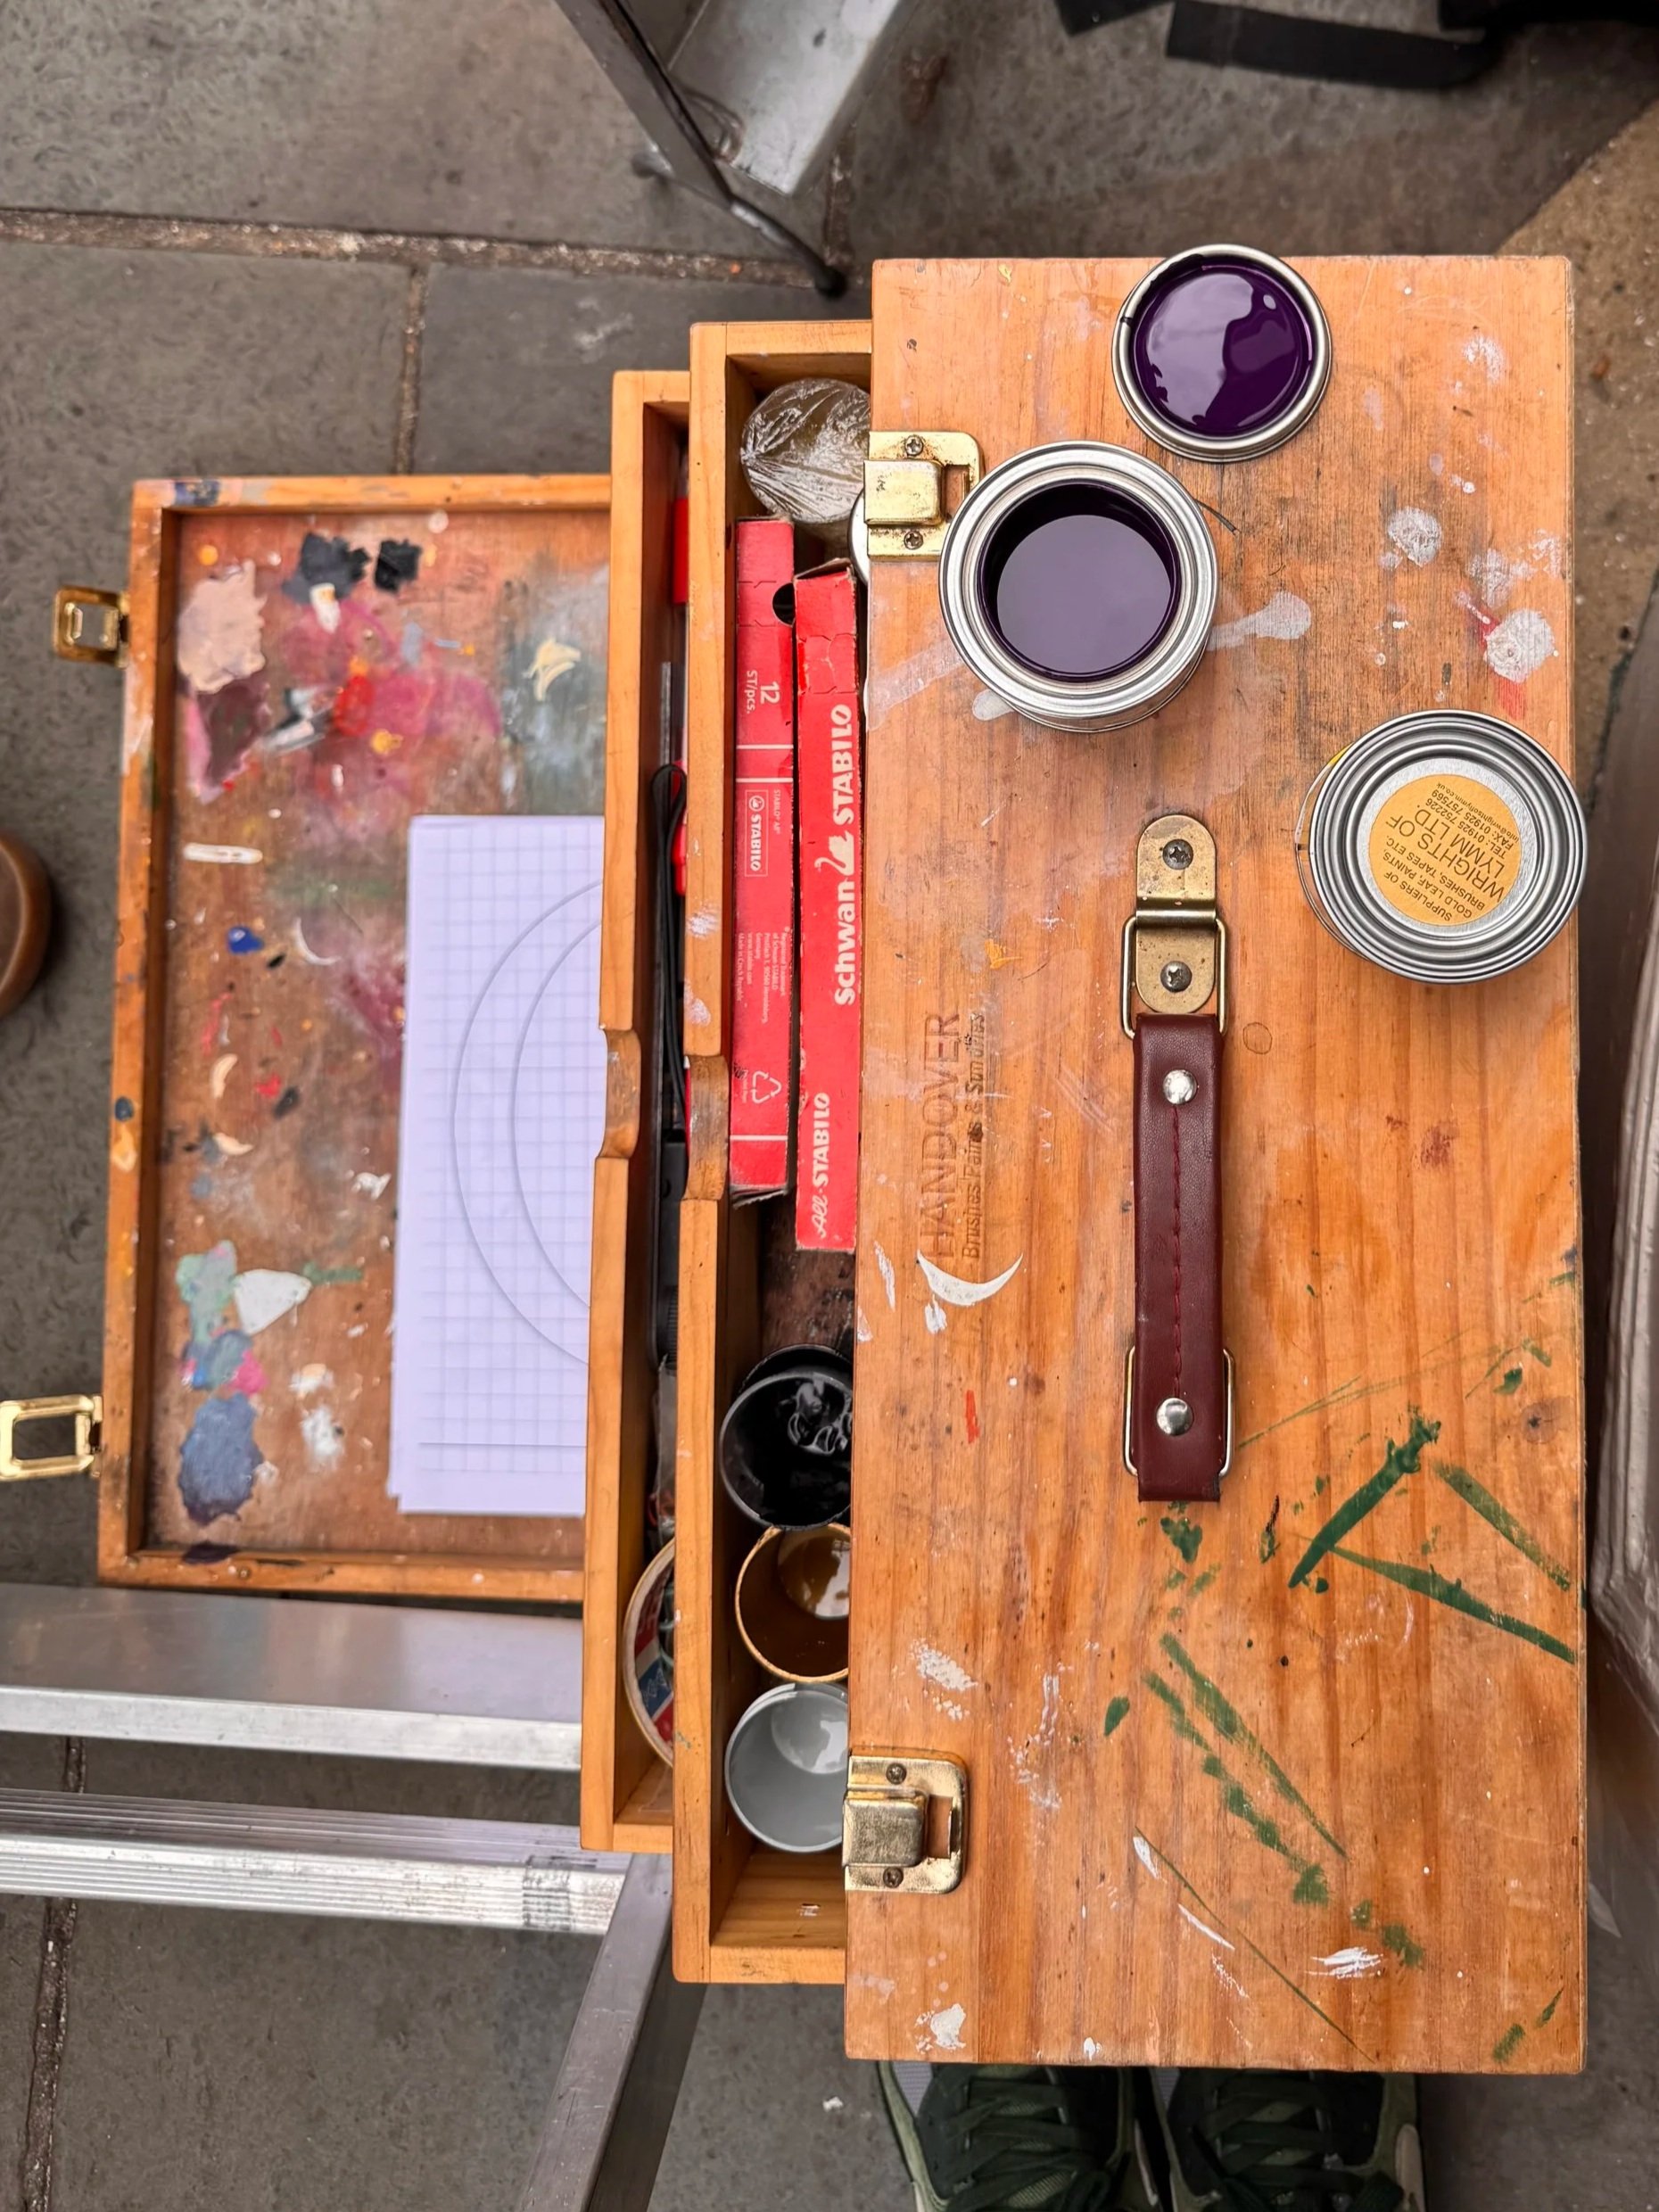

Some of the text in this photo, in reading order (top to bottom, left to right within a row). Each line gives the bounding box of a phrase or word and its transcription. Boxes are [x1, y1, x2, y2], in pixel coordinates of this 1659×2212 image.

[744, 669, 759, 714] ST/pcs.
[760, 681, 781, 705] 12
[750, 813, 763, 871] STABILO
[1415, 804, 1506, 879] LYMM LTD.
[1425, 797, 1506, 860] TEL: 01925 752226
[1432, 788, 1515, 851] FAX: 01925 757569
[1436, 781, 1520, 844] info@wrightsoflymm.co.uk
[830, 703, 857, 1005] Schwan STABILO
[1382, 849, 1473, 919] GOLD LEAF, PAINTS,
[1385, 814, 1506, 903] WRIGHTS OF
[1386, 835, 1485, 912] BRUSHES, TAPES ETC.
[1383, 871, 1453, 921] SUPPLIERS OF
[920, 1013, 961, 1259] HANDOVER
[964, 1100, 982, 1115] &
[962, 1184, 983, 1259] Brushes
